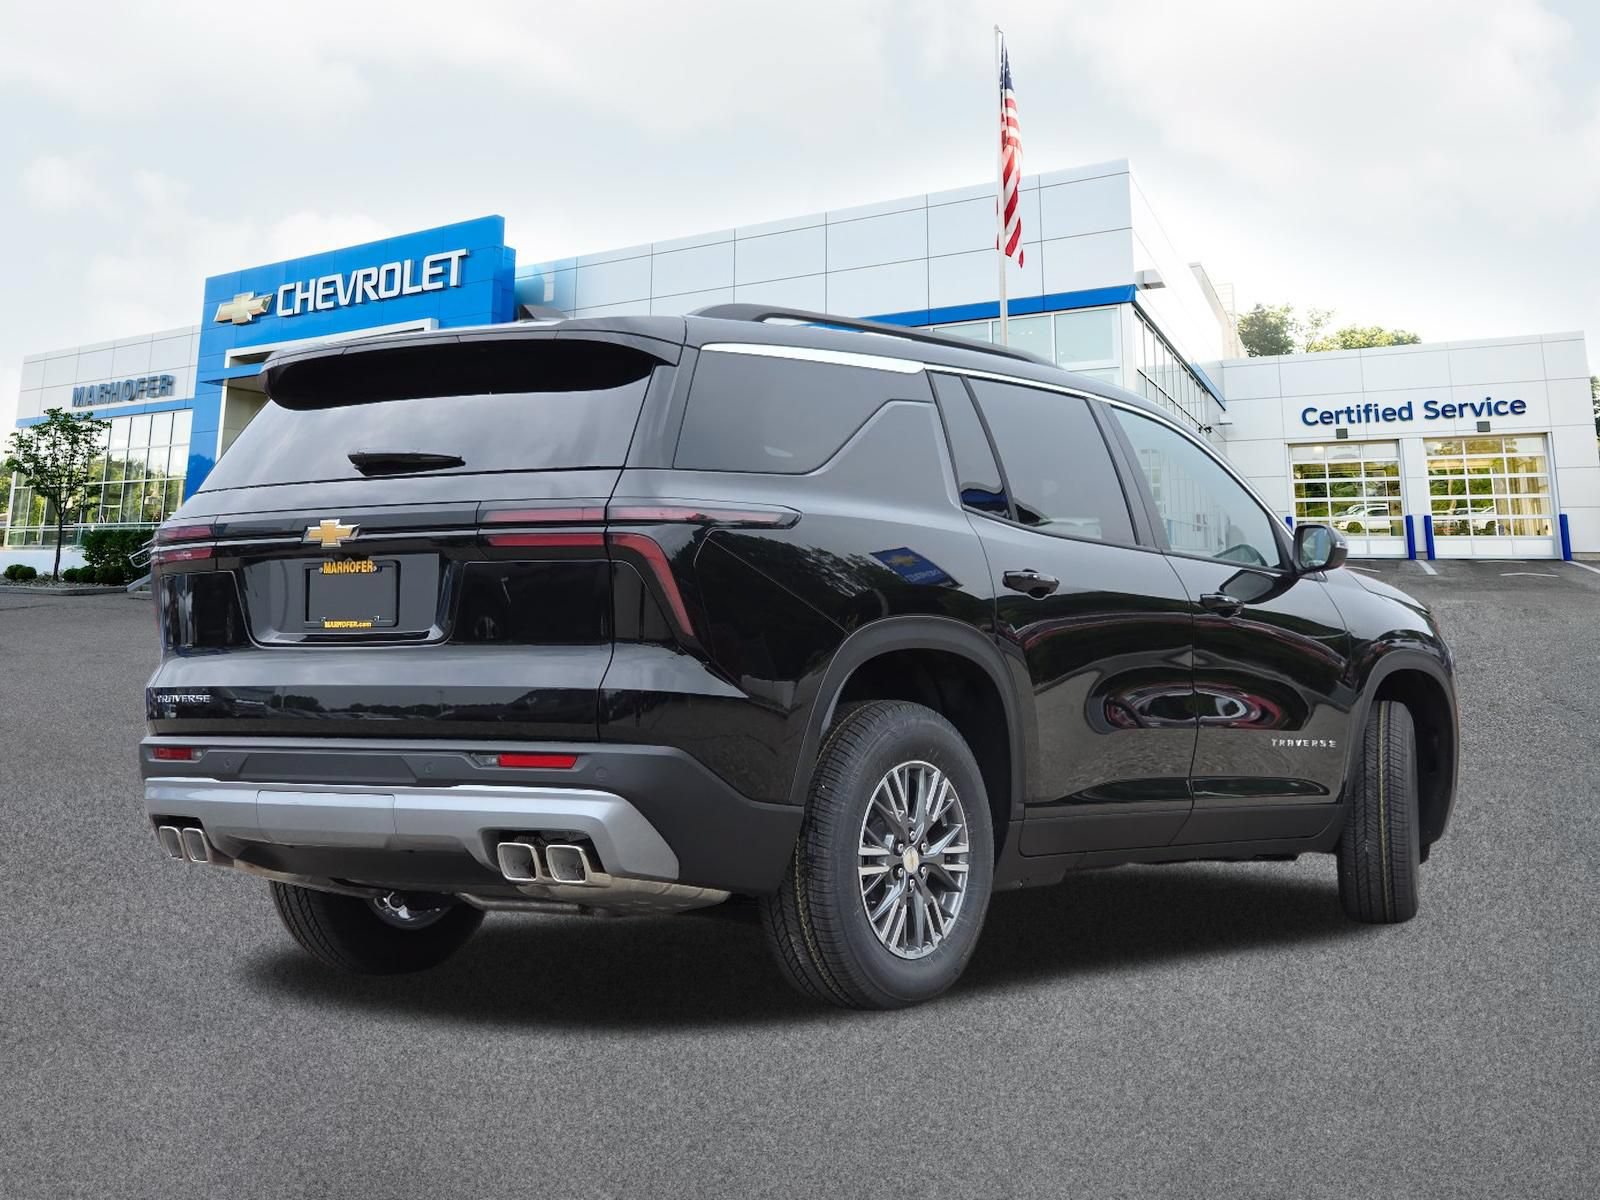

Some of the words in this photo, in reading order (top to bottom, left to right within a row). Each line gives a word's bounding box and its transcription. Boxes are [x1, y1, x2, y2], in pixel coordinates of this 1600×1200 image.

[276, 248, 469, 317] CHEVROLET
[72, 375, 175, 407] MARHOFER
[1301, 401, 1414, 426] Certified
[1423, 396, 1528, 420] Service
[323, 561, 374, 573] MARHOFER
[1271, 738, 1337, 748] TRAVERSE
